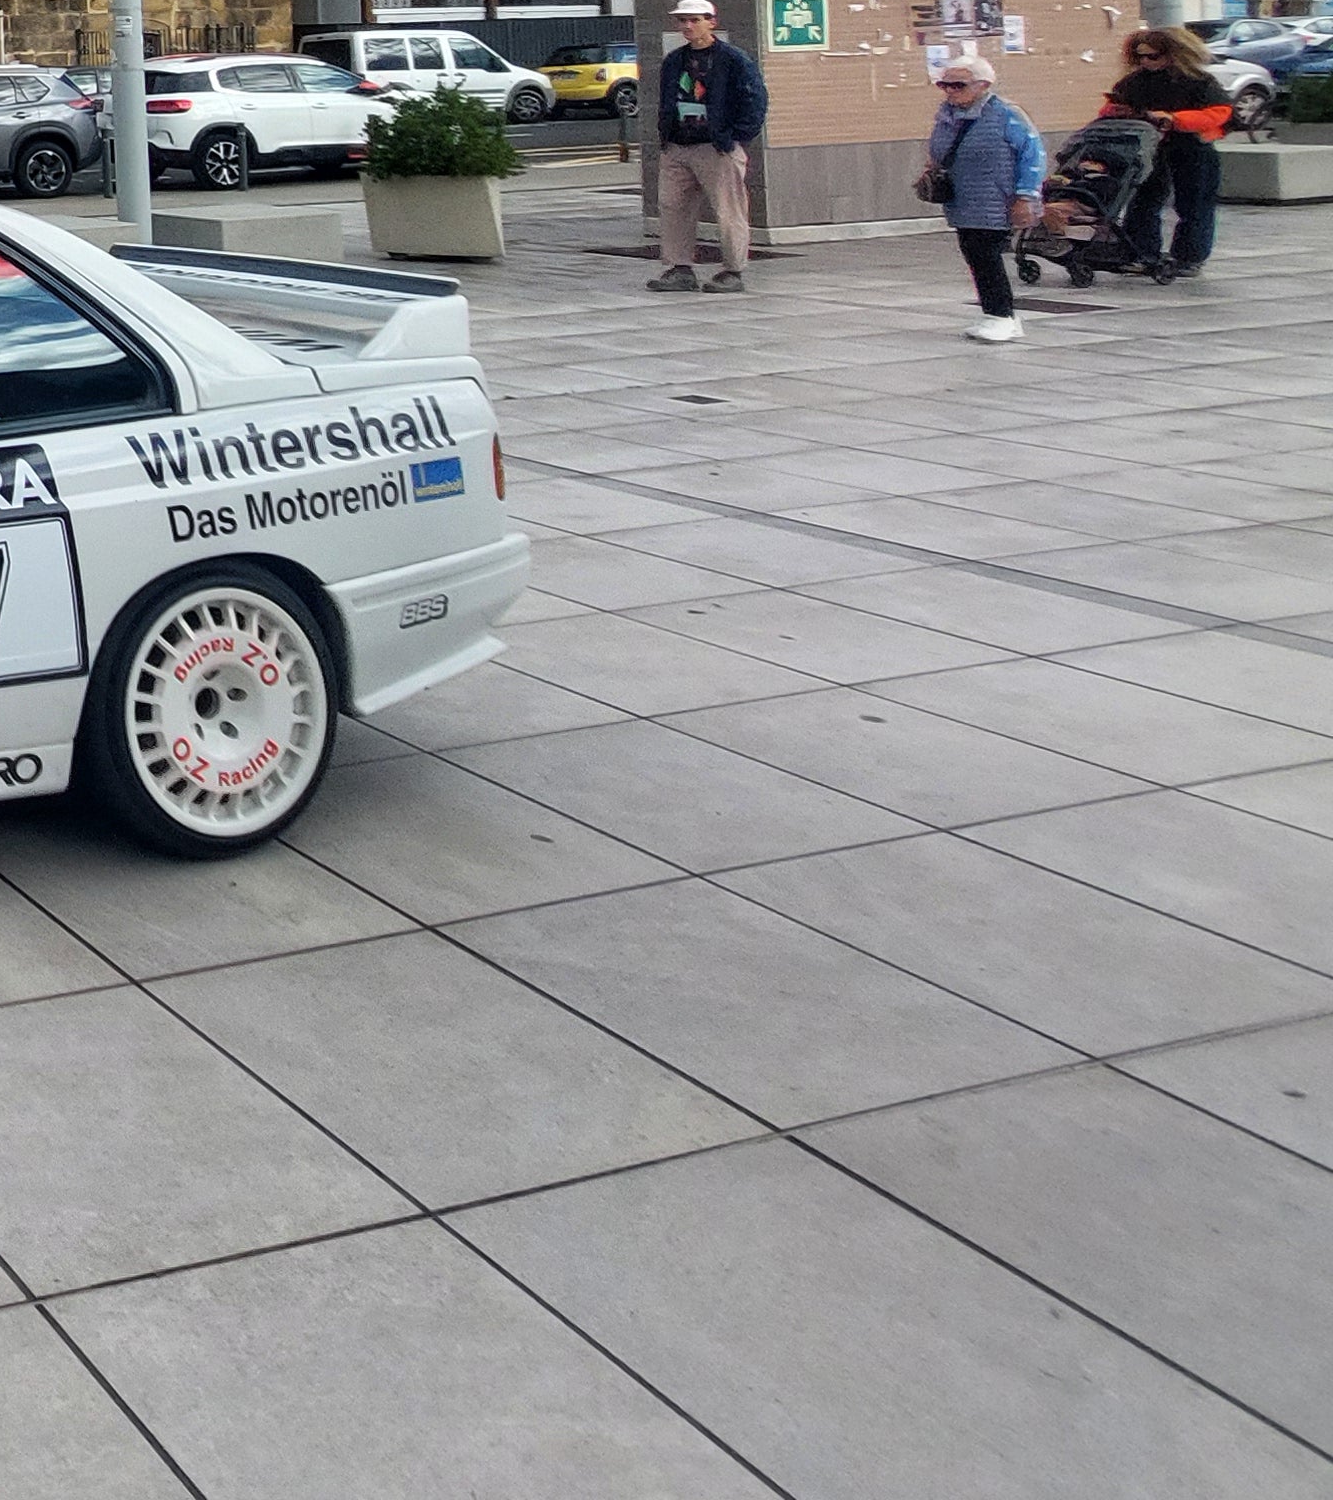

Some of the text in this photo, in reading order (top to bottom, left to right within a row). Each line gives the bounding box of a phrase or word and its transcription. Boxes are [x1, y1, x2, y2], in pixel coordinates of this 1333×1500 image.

[124, 395, 457, 489] Wintershall
[165, 504, 238, 543] Das
[243, 470, 408, 530] Motorenöl
[399, 593, 449, 629] BBS
[173, 636, 235, 684] Racing
[217, 737, 280, 787] Racing
